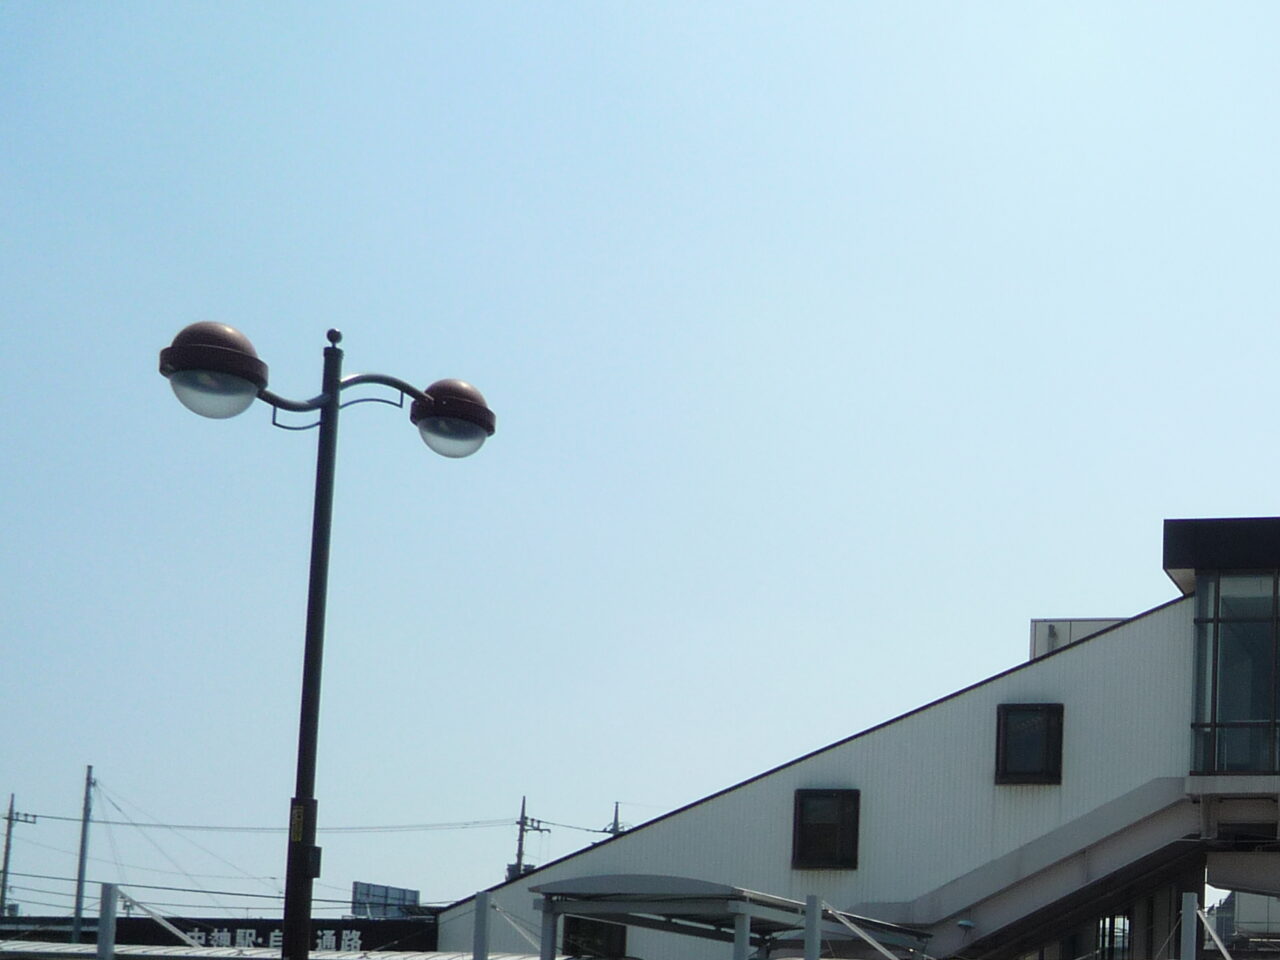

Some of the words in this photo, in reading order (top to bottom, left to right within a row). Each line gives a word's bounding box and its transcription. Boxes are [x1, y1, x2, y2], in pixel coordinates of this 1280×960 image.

[186, 928, 363, 952] 中神駅・自通路
